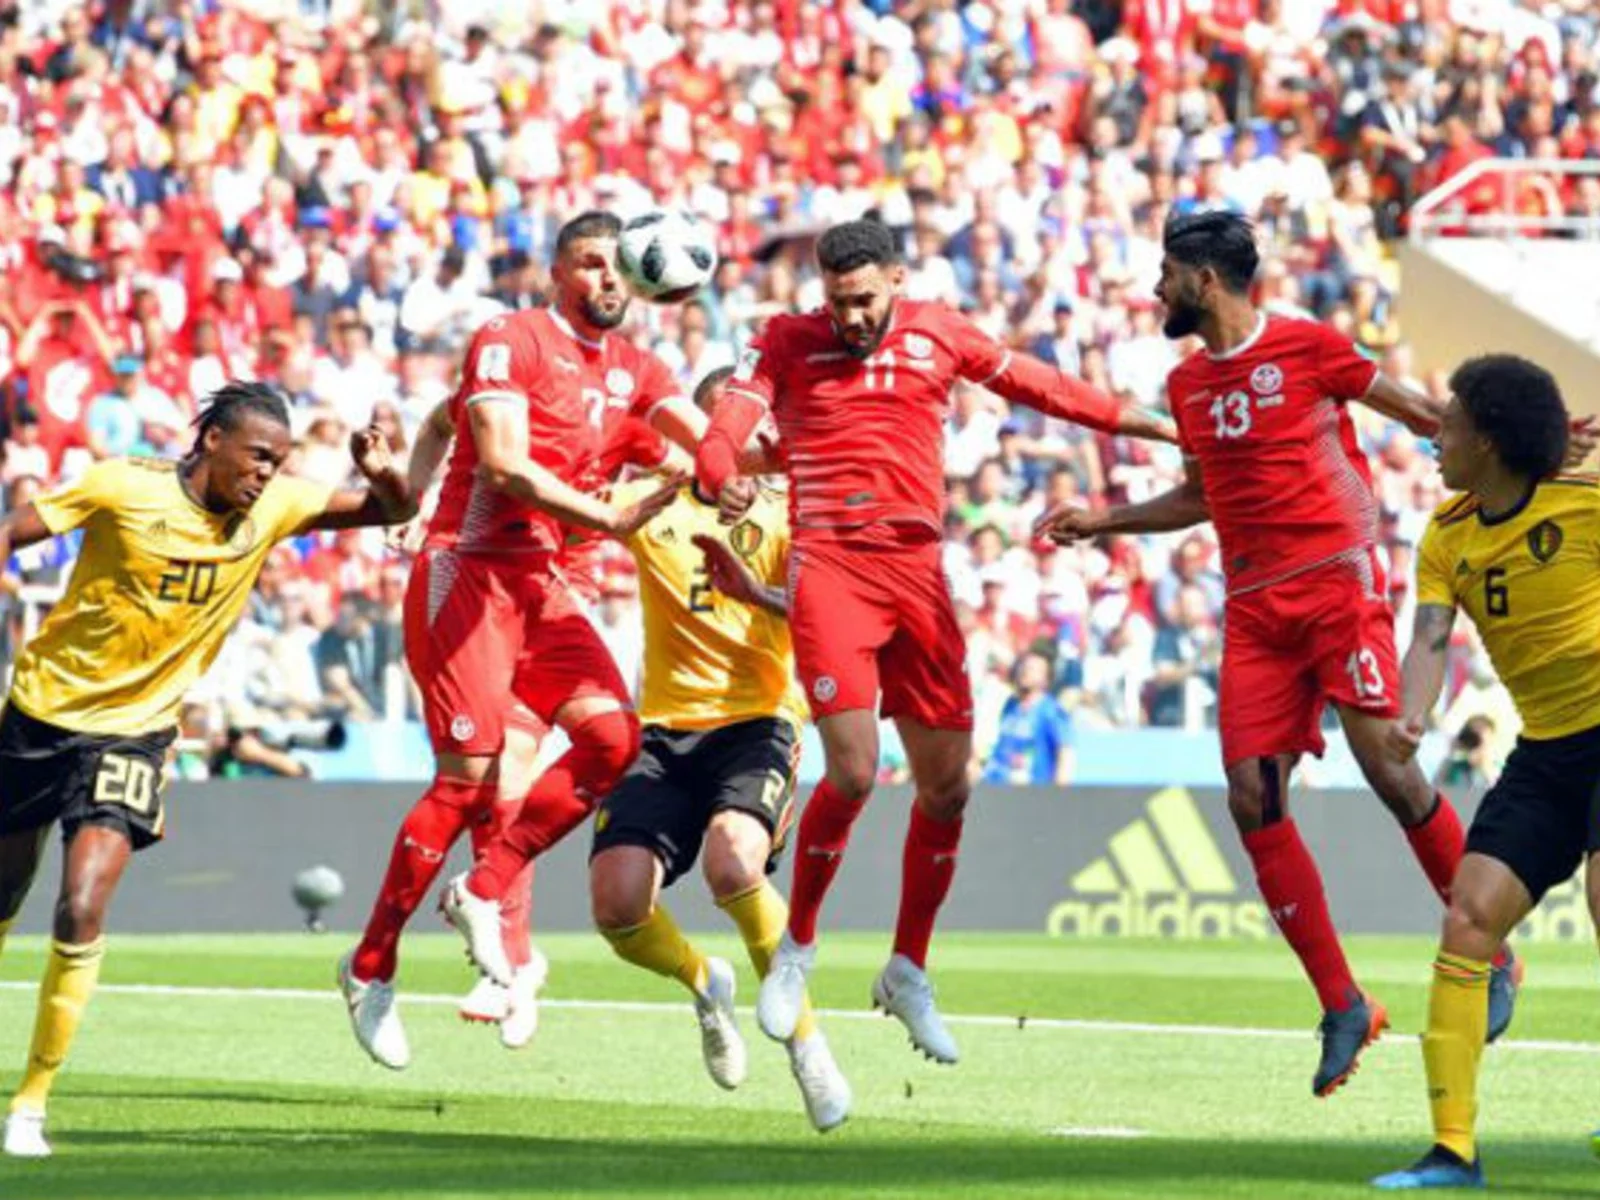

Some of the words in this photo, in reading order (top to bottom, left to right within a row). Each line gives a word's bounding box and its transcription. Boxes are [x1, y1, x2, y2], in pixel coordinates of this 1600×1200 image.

[864, 349, 895, 390] 11
[581, 387, 604, 427] 7
[1209, 391, 1252, 438] 13
[158, 559, 217, 605] 20
[1485, 567, 1508, 617] 6
[1346, 648, 1384, 699] 13
[94, 754, 155, 812] 20
[762, 768, 786, 813] 2
[1047, 888, 1270, 940] adidas
